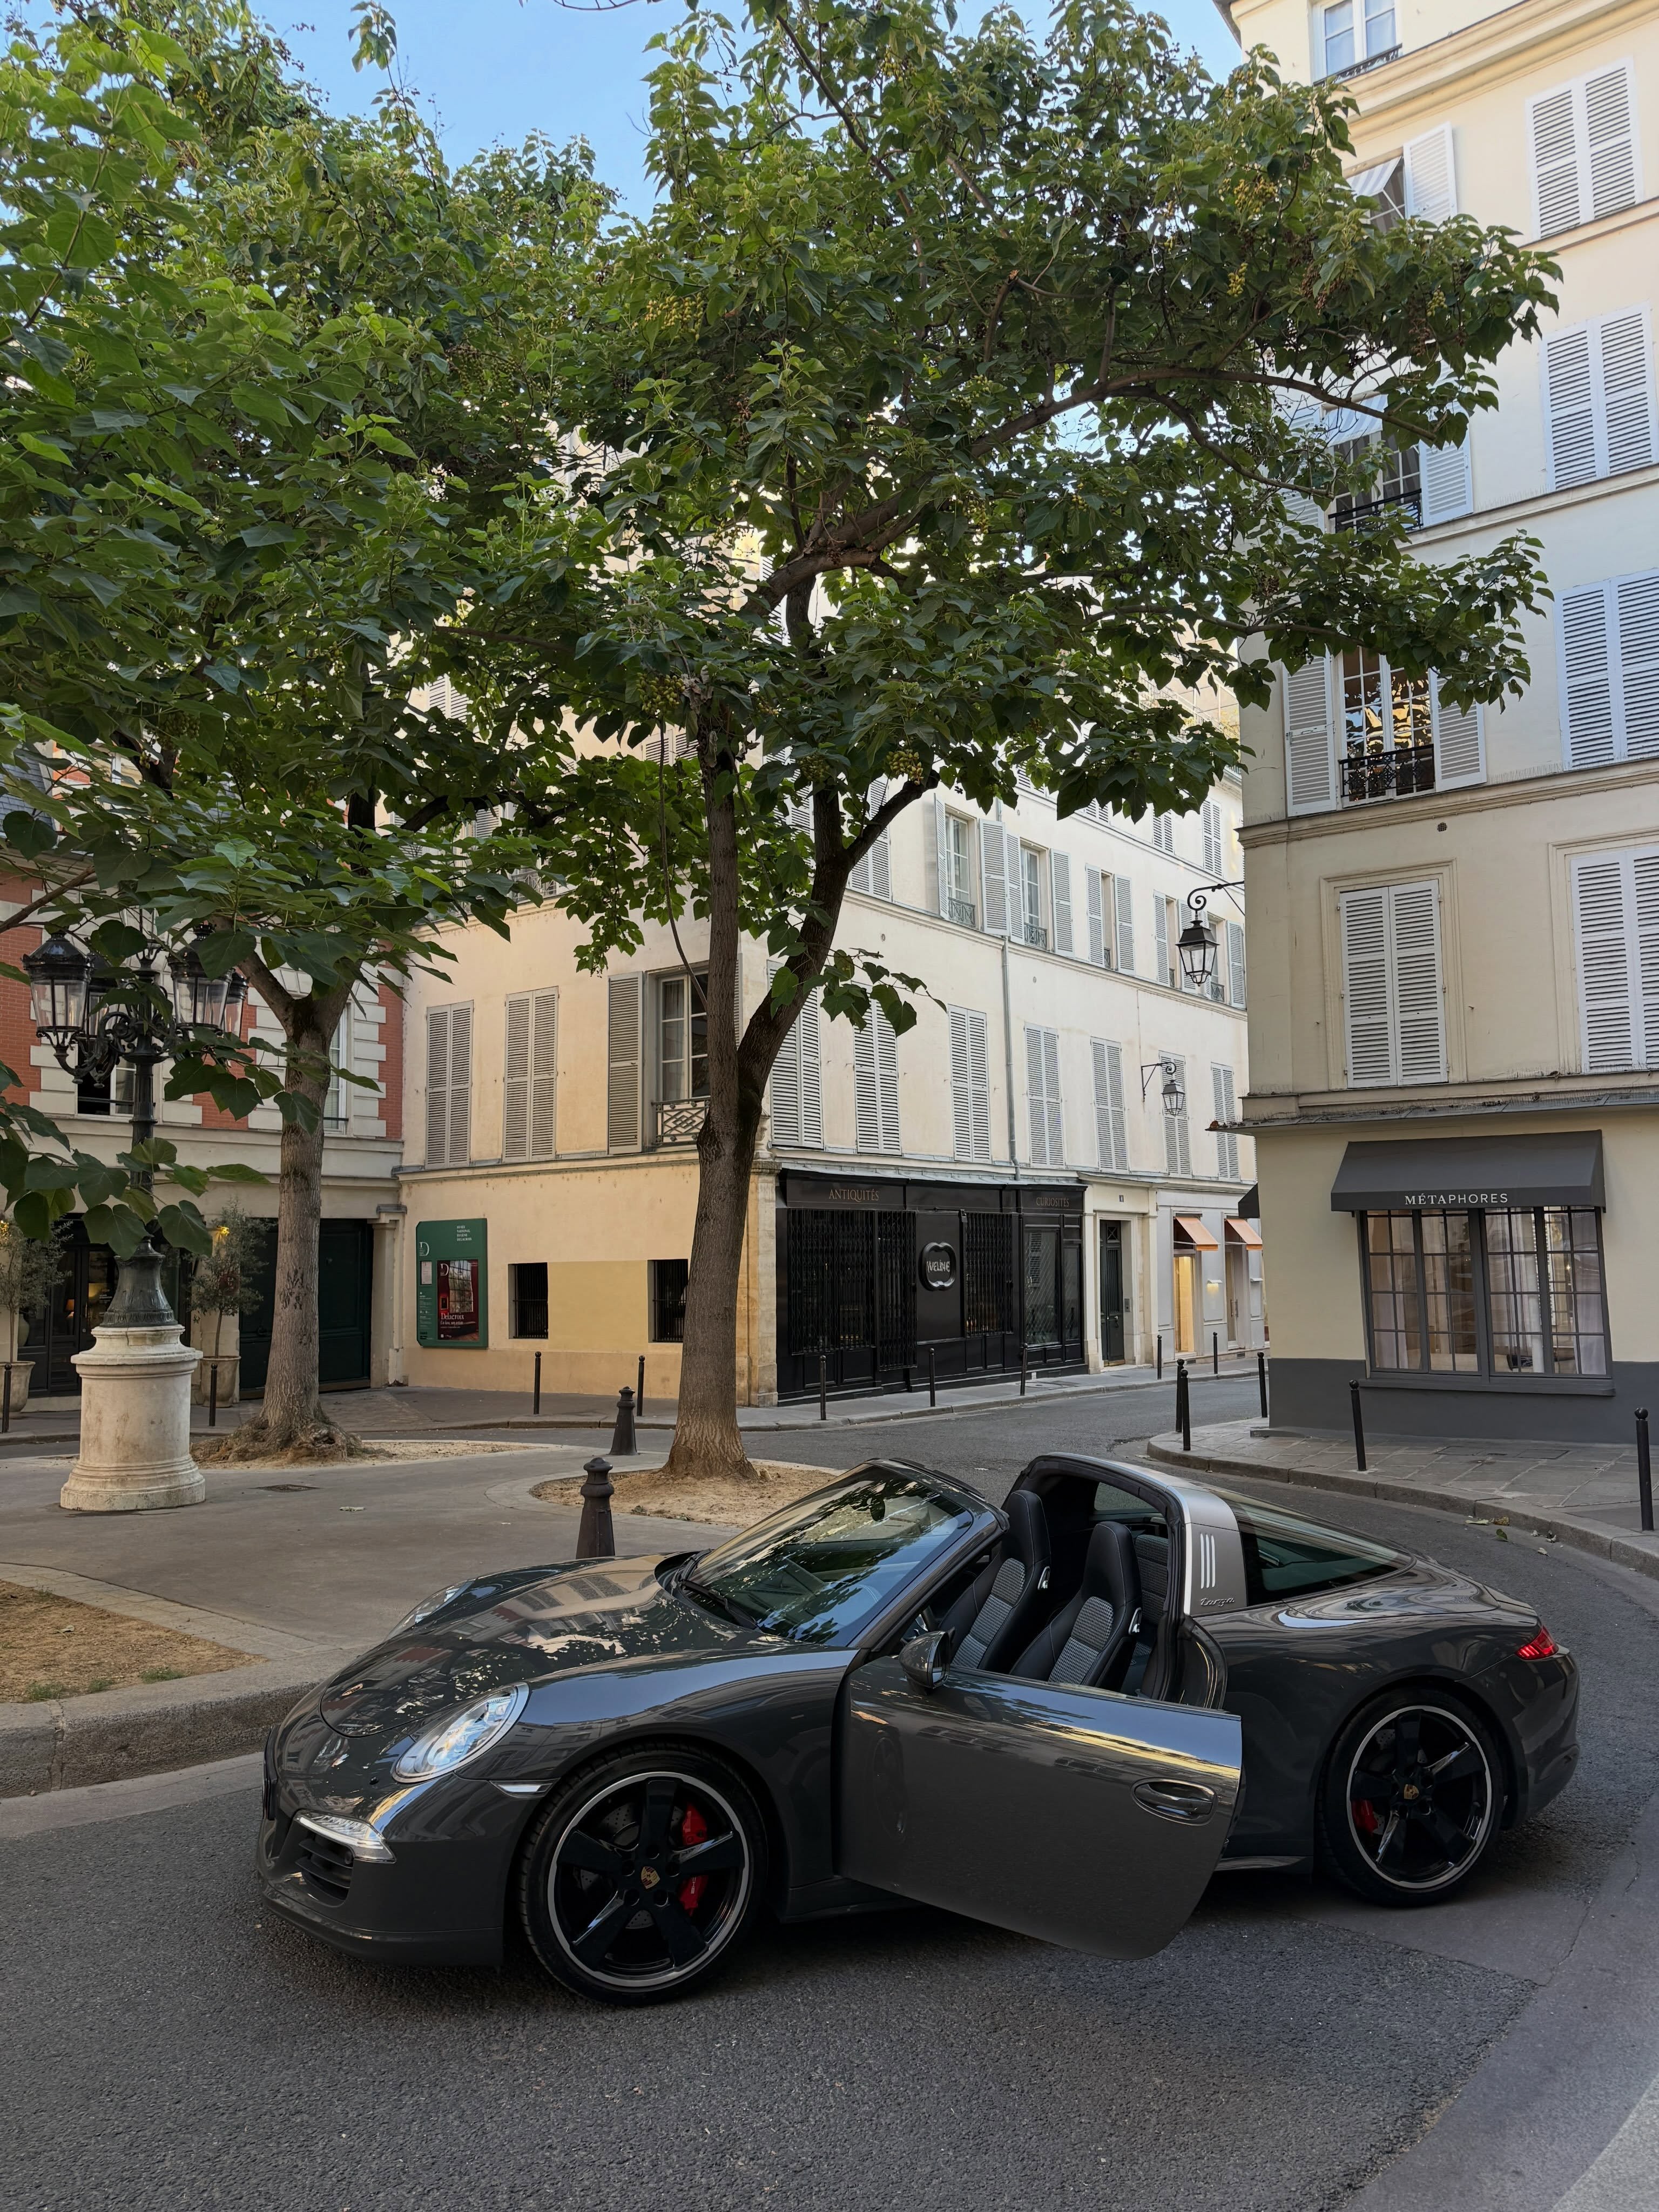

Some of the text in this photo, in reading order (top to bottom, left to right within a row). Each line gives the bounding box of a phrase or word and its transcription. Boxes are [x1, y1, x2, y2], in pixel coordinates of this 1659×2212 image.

[829, 1189, 879, 1203] ANTIQUITÉS
[1036, 1196, 1070, 1207] CURIOSITÉS
[1405, 1193, 1508, 1205] MÉTAPHORES
